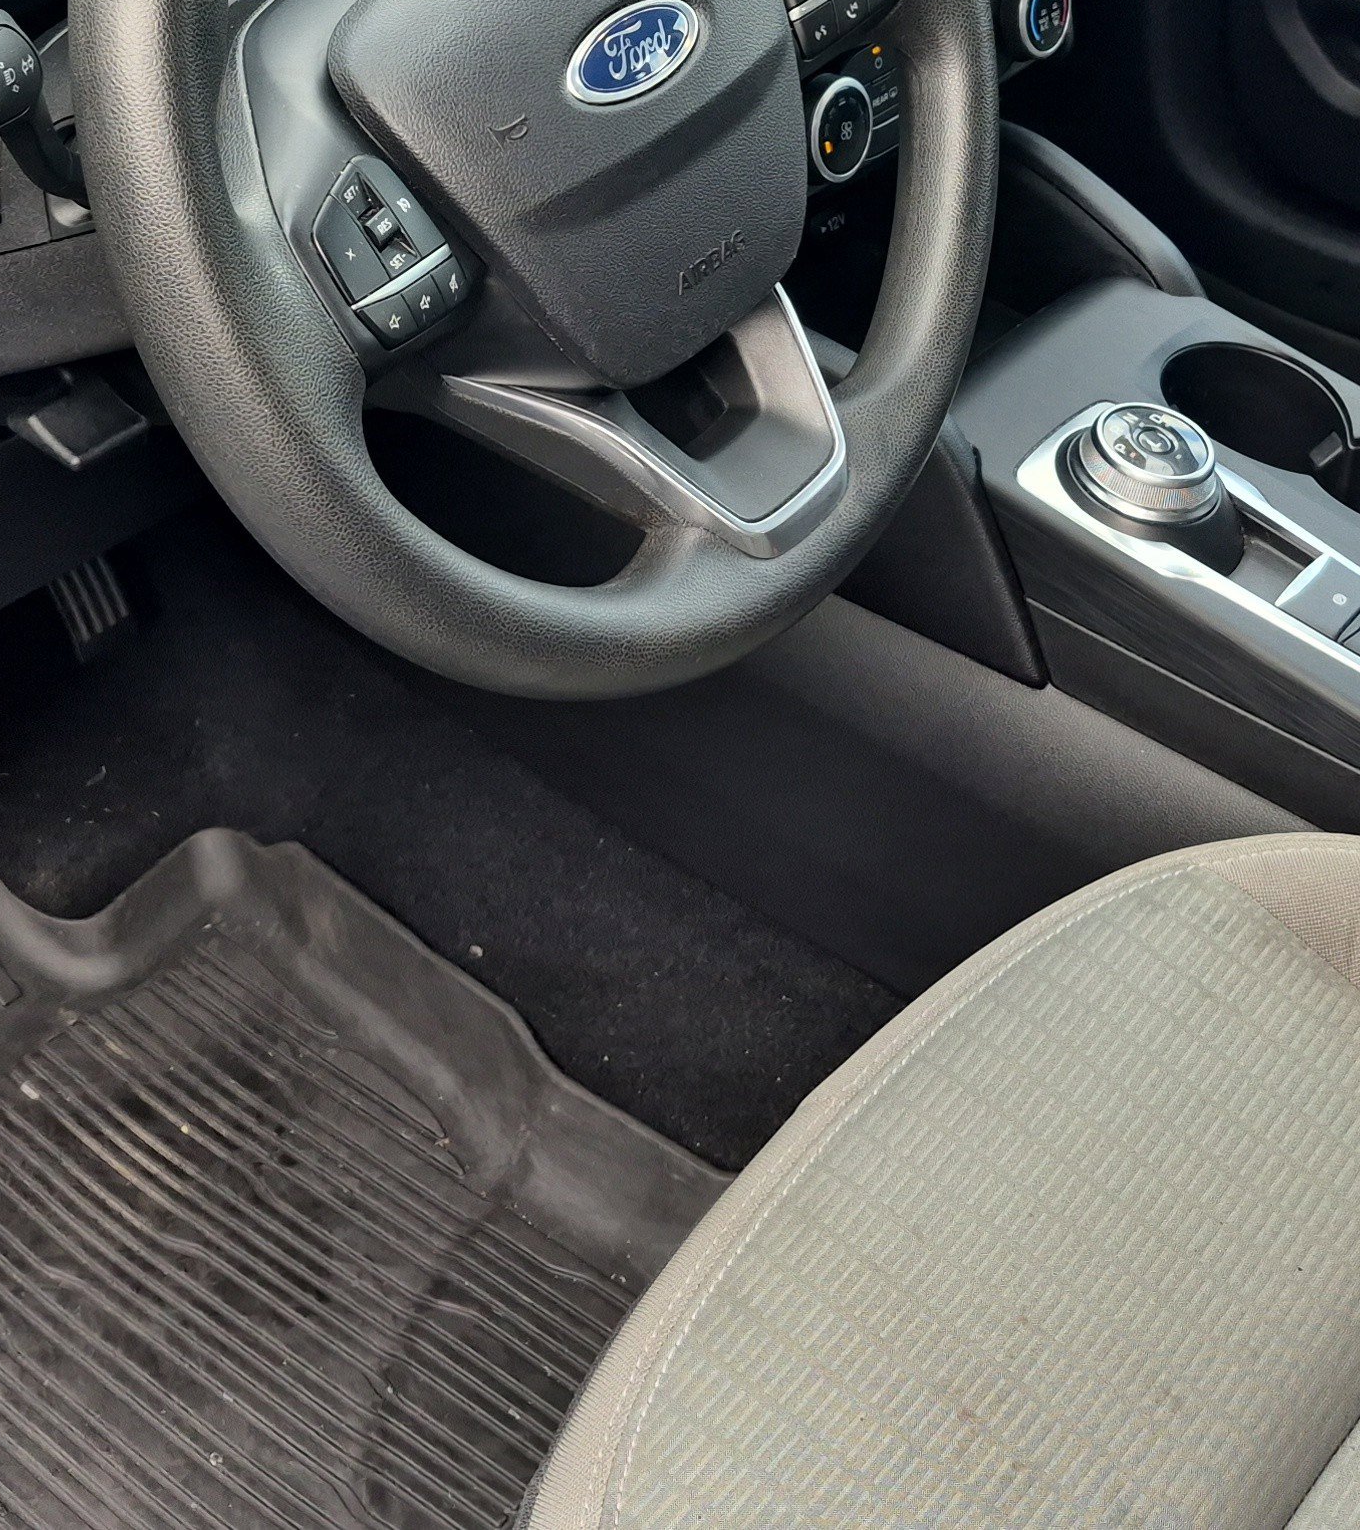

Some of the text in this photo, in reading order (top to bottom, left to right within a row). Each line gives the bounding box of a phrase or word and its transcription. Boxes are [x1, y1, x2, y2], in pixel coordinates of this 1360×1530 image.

[604, 19, 671, 80] Ford
[872, 91, 889, 108] REAR
[376, 217, 393, 235] RES
[827, 212, 846, 232] 12V
[1114, 443, 1126, 455] P
